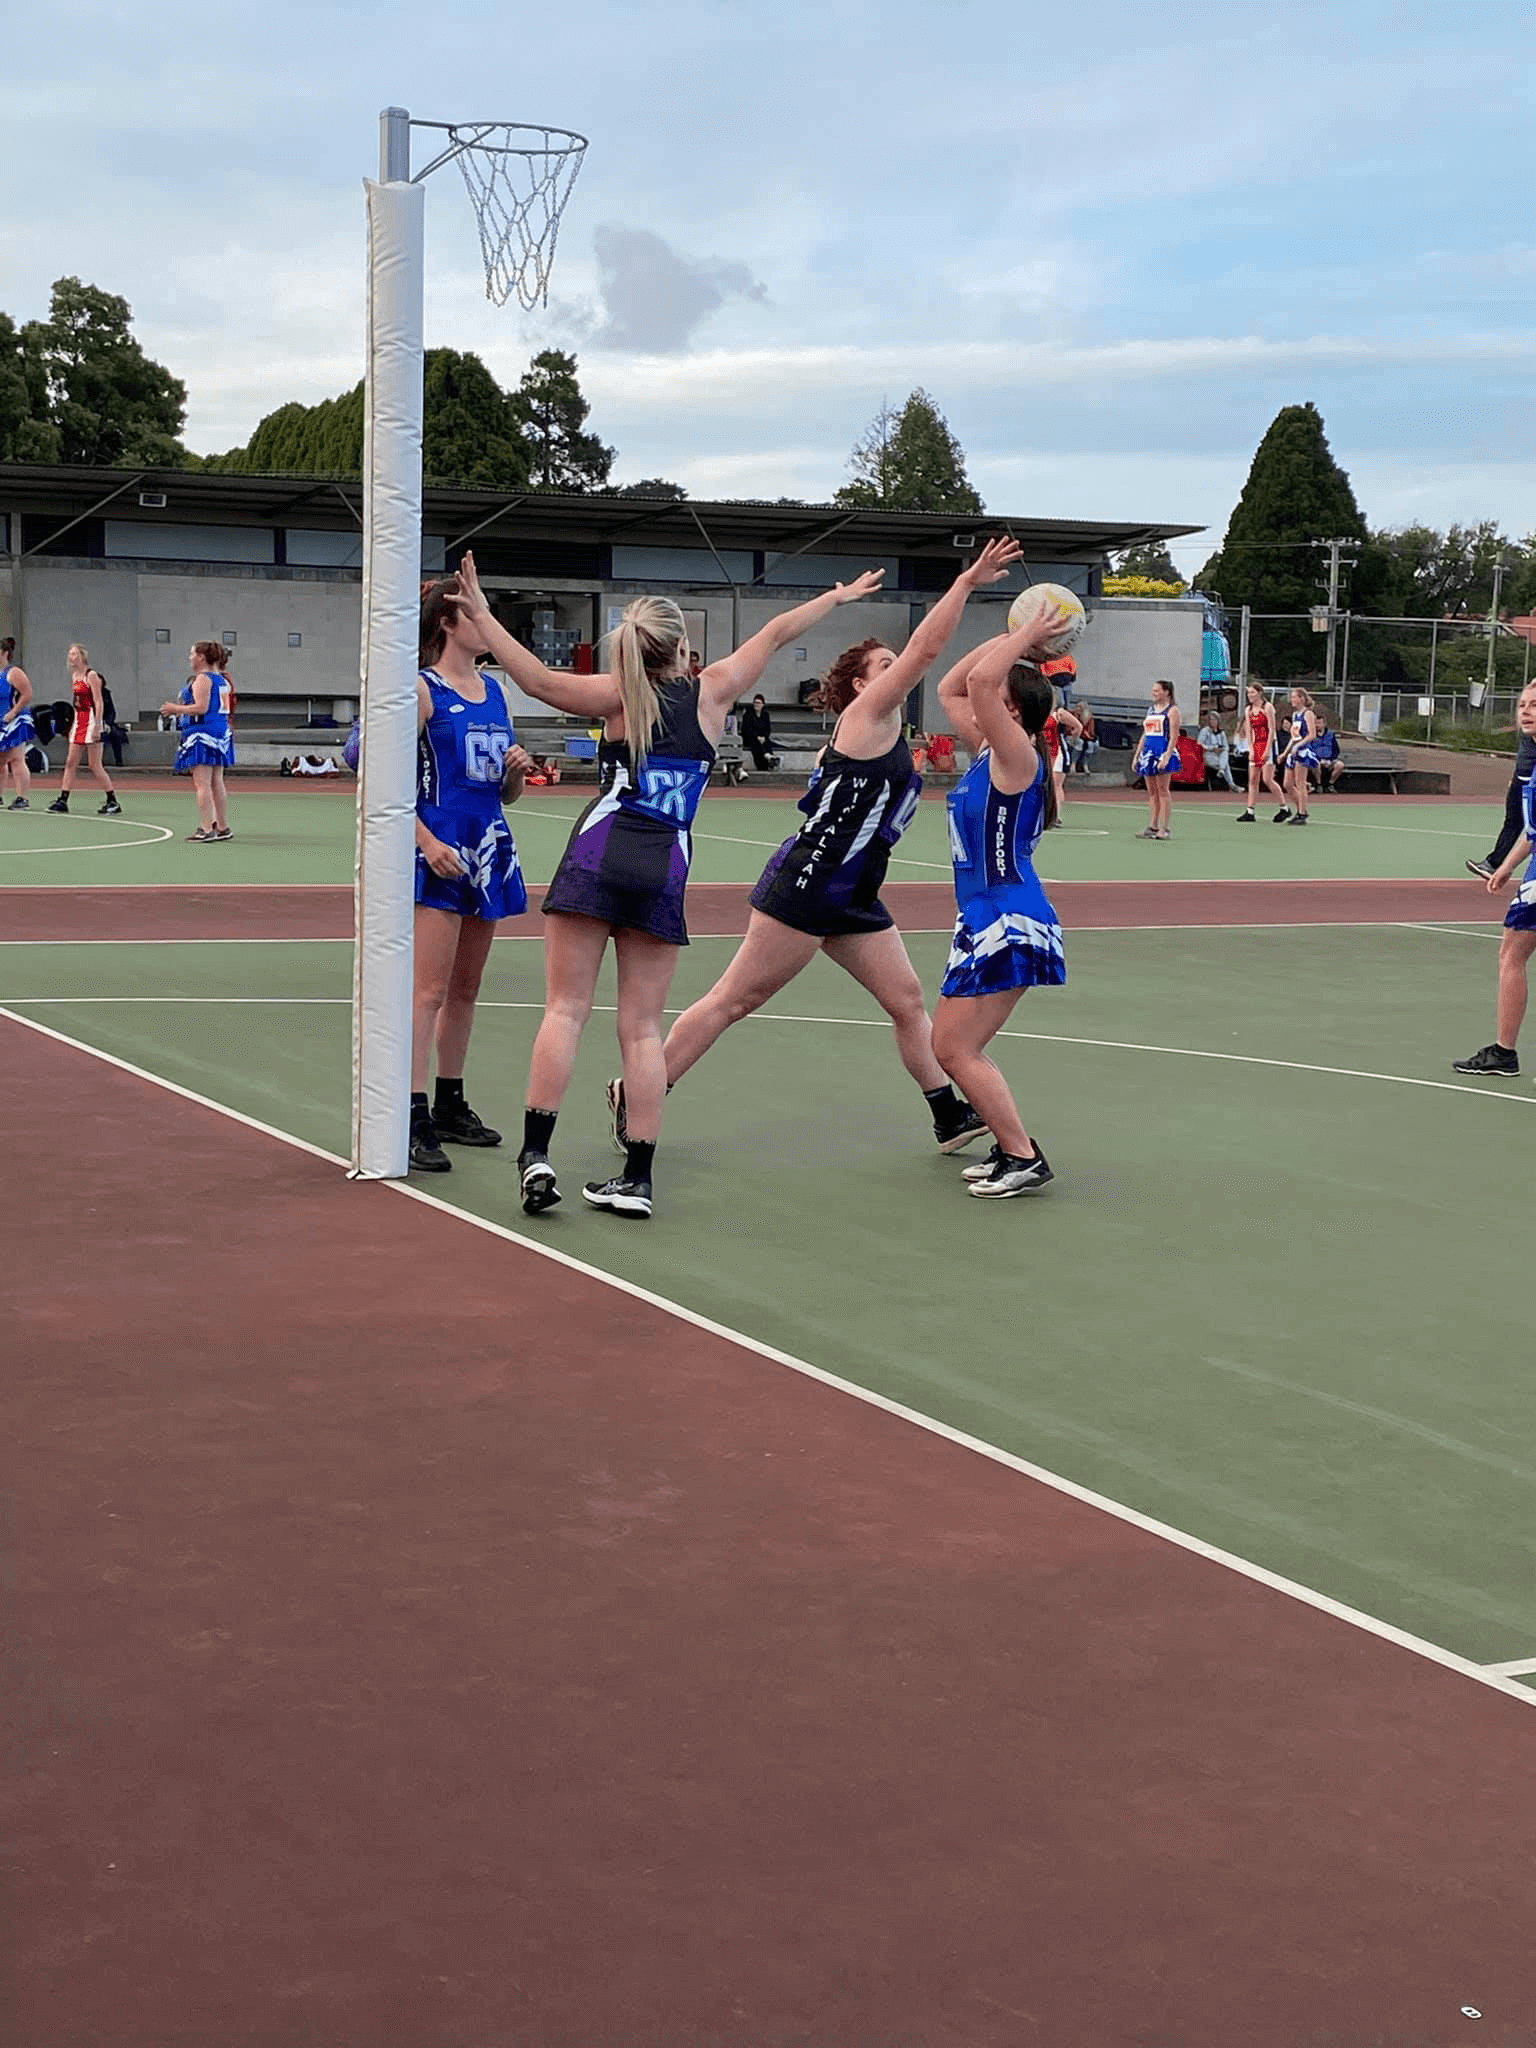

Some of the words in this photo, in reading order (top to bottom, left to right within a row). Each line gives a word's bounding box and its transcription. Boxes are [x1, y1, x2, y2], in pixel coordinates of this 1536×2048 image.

[465, 731, 510, 782] GS
[796, 777, 868, 889] WIALEAH
[995, 806, 1008, 877] BRIDPORT
